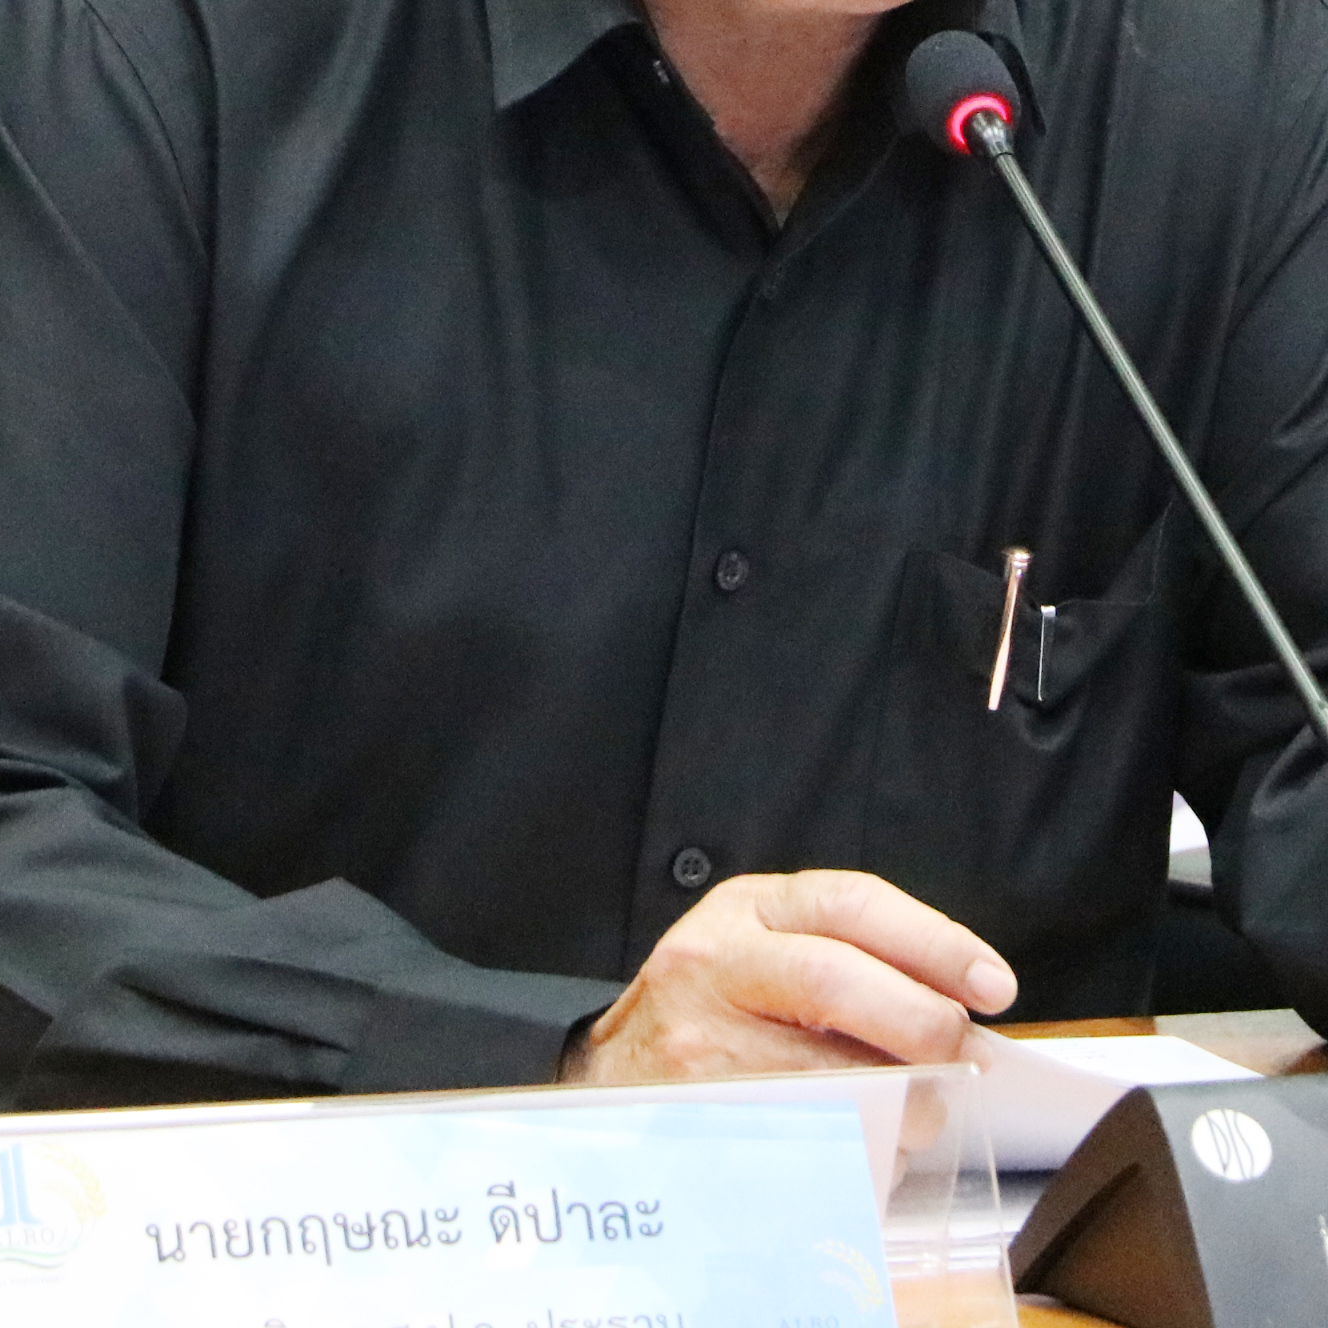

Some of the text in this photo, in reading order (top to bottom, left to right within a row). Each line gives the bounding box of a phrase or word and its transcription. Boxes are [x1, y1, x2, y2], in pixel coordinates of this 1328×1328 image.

[145, 1180, 664, 1267] นายกฤษณะ ดีปาละ
